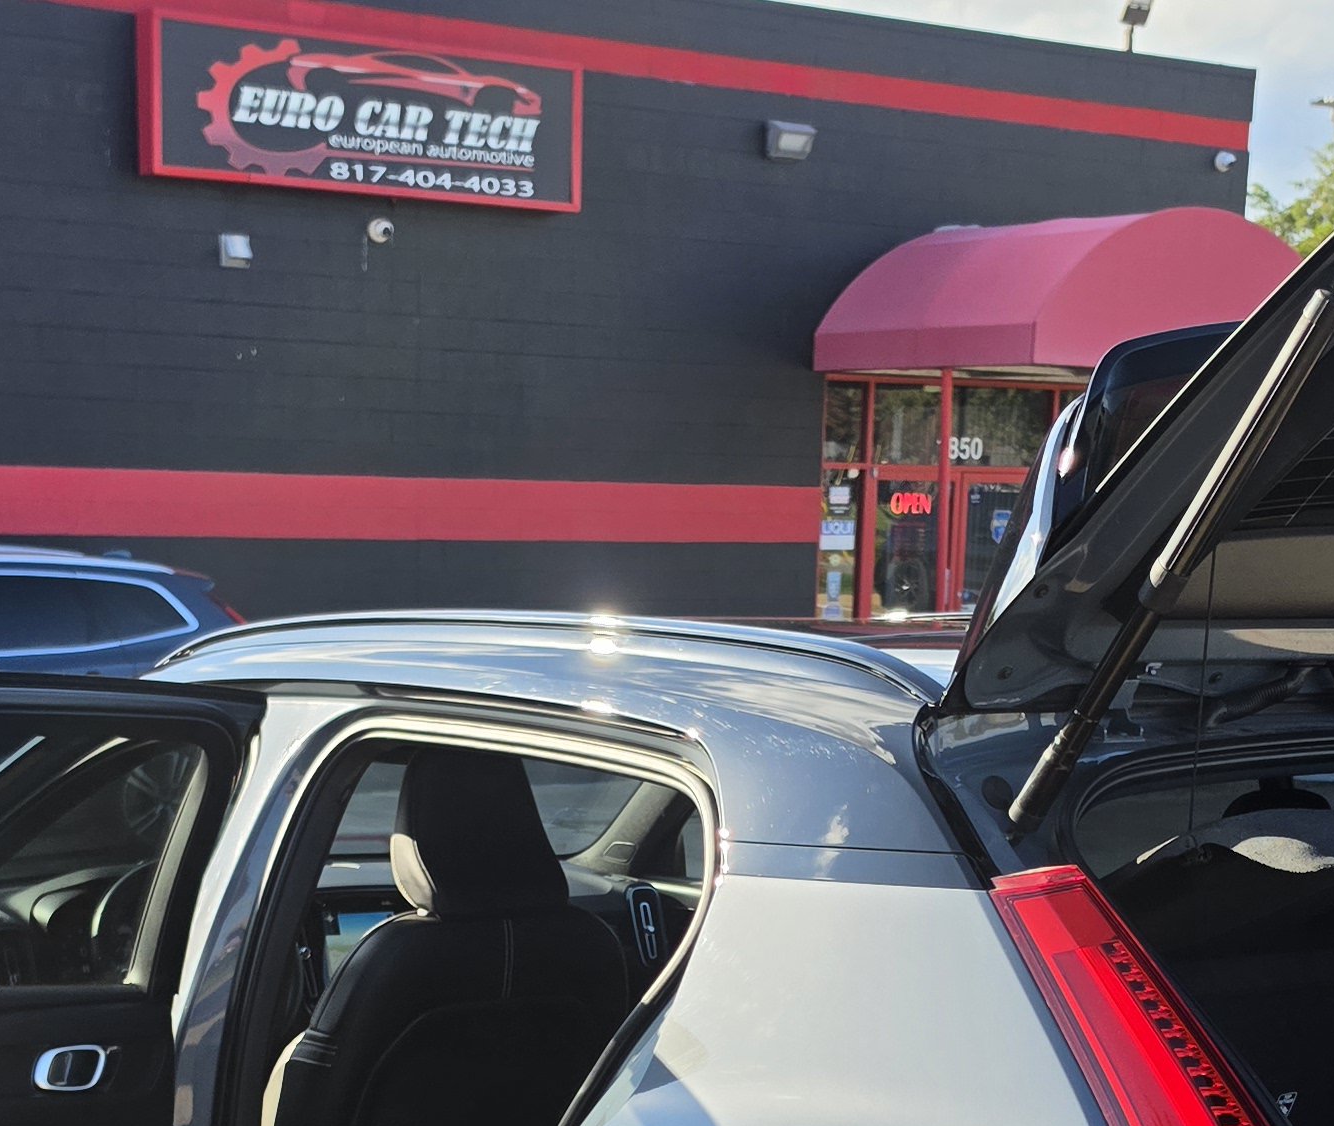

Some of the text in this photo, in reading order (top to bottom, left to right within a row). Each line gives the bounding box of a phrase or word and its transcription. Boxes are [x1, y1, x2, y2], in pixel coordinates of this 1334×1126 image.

[232, 85, 540, 153] EURO CAR TECH
[328, 133, 535, 168] european automotive
[329, 162, 534, 198] 817-404-4033
[890, 492, 932, 515] OPEN
